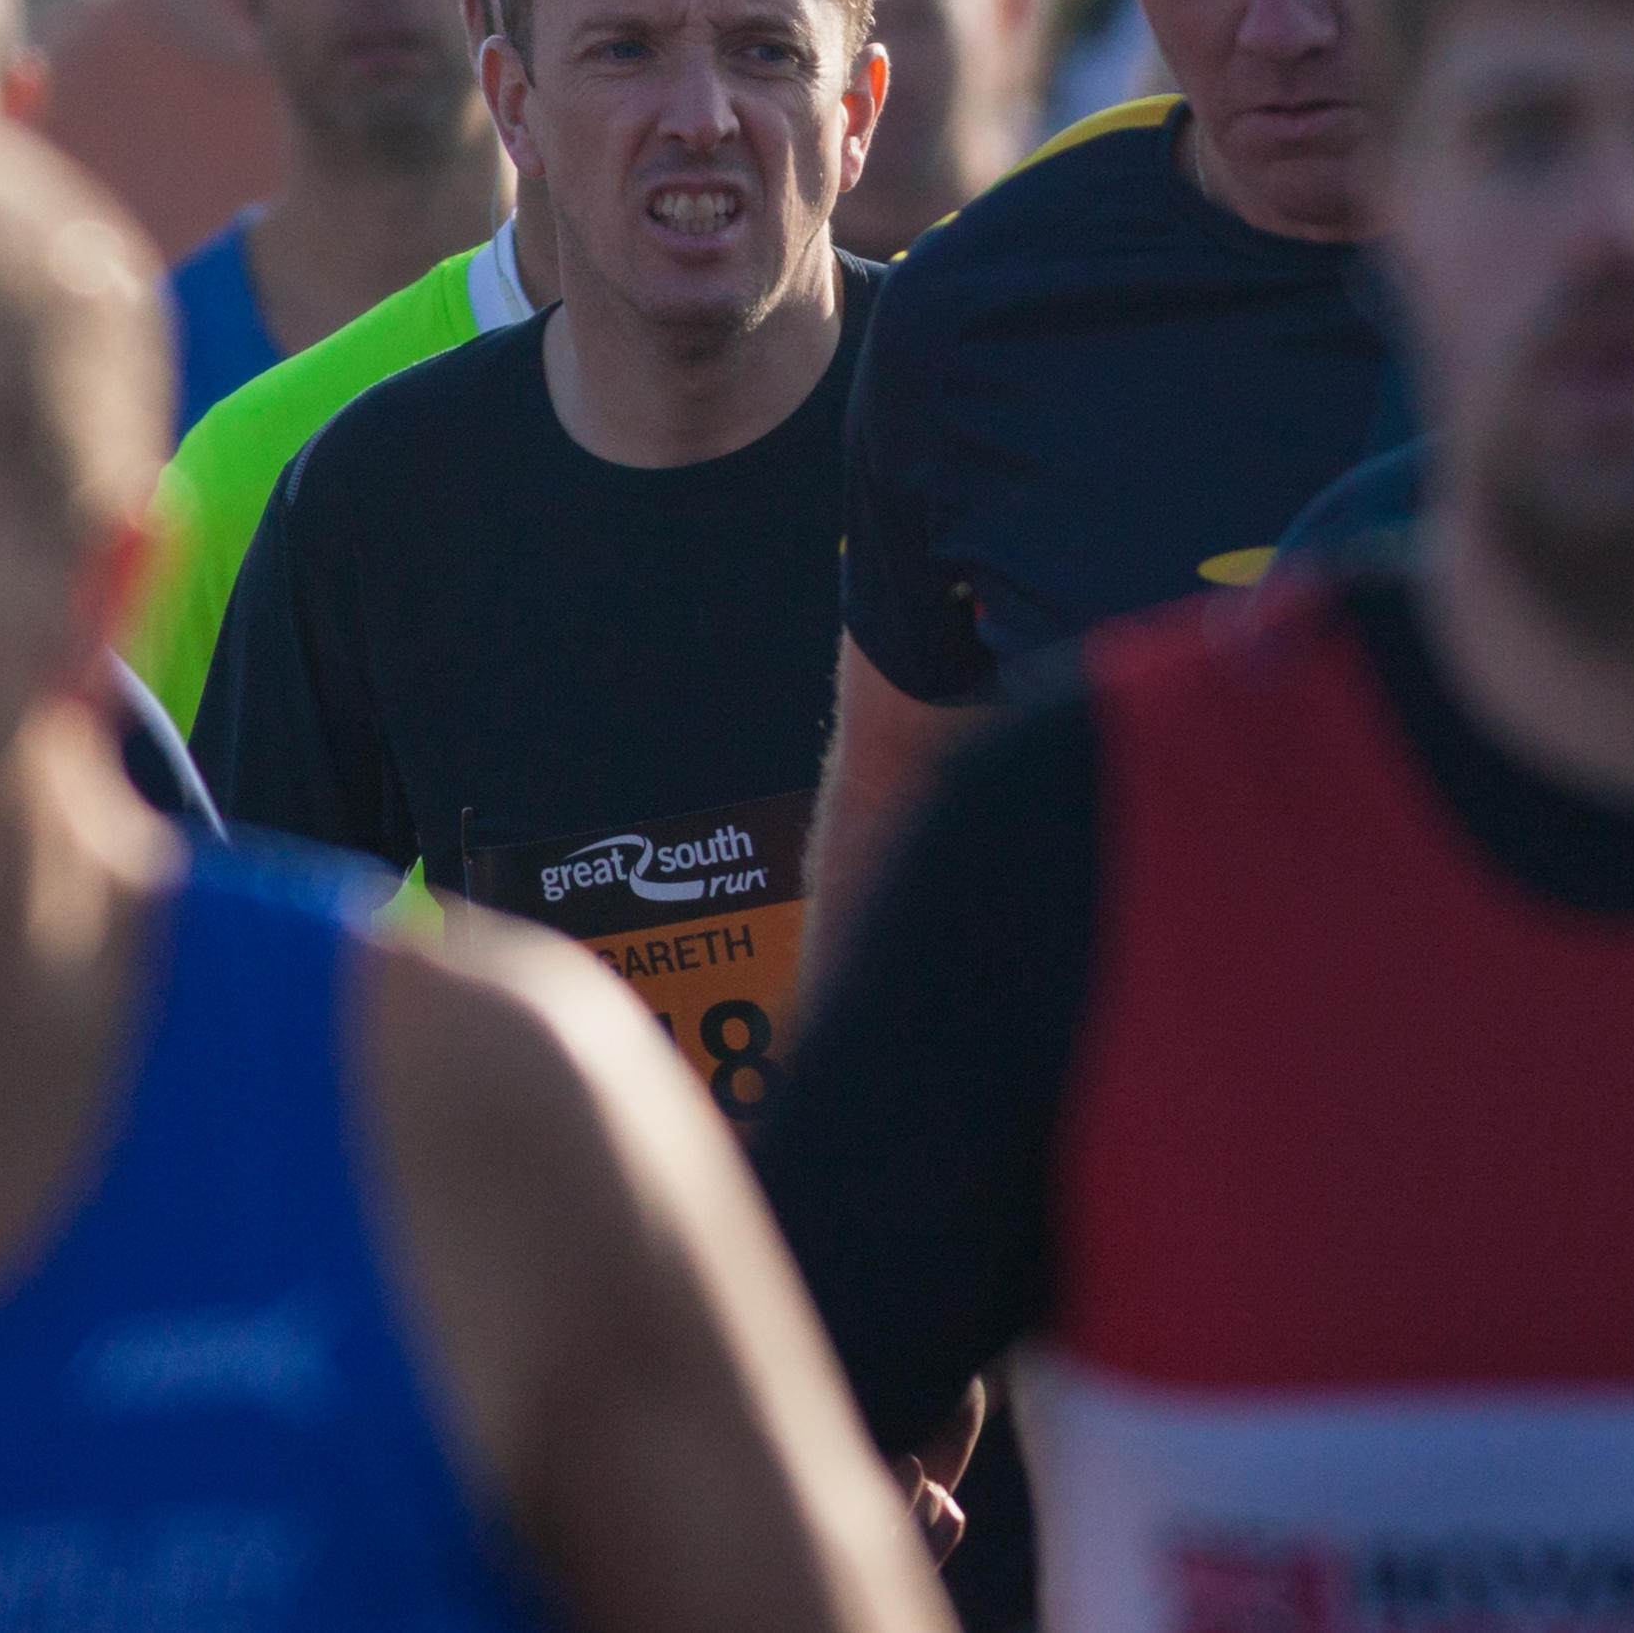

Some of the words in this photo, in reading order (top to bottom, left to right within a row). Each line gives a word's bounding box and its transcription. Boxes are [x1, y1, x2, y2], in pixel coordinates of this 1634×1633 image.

[540, 847, 628, 902] great
[657, 825, 754, 873] south
[709, 868, 766, 898] run
